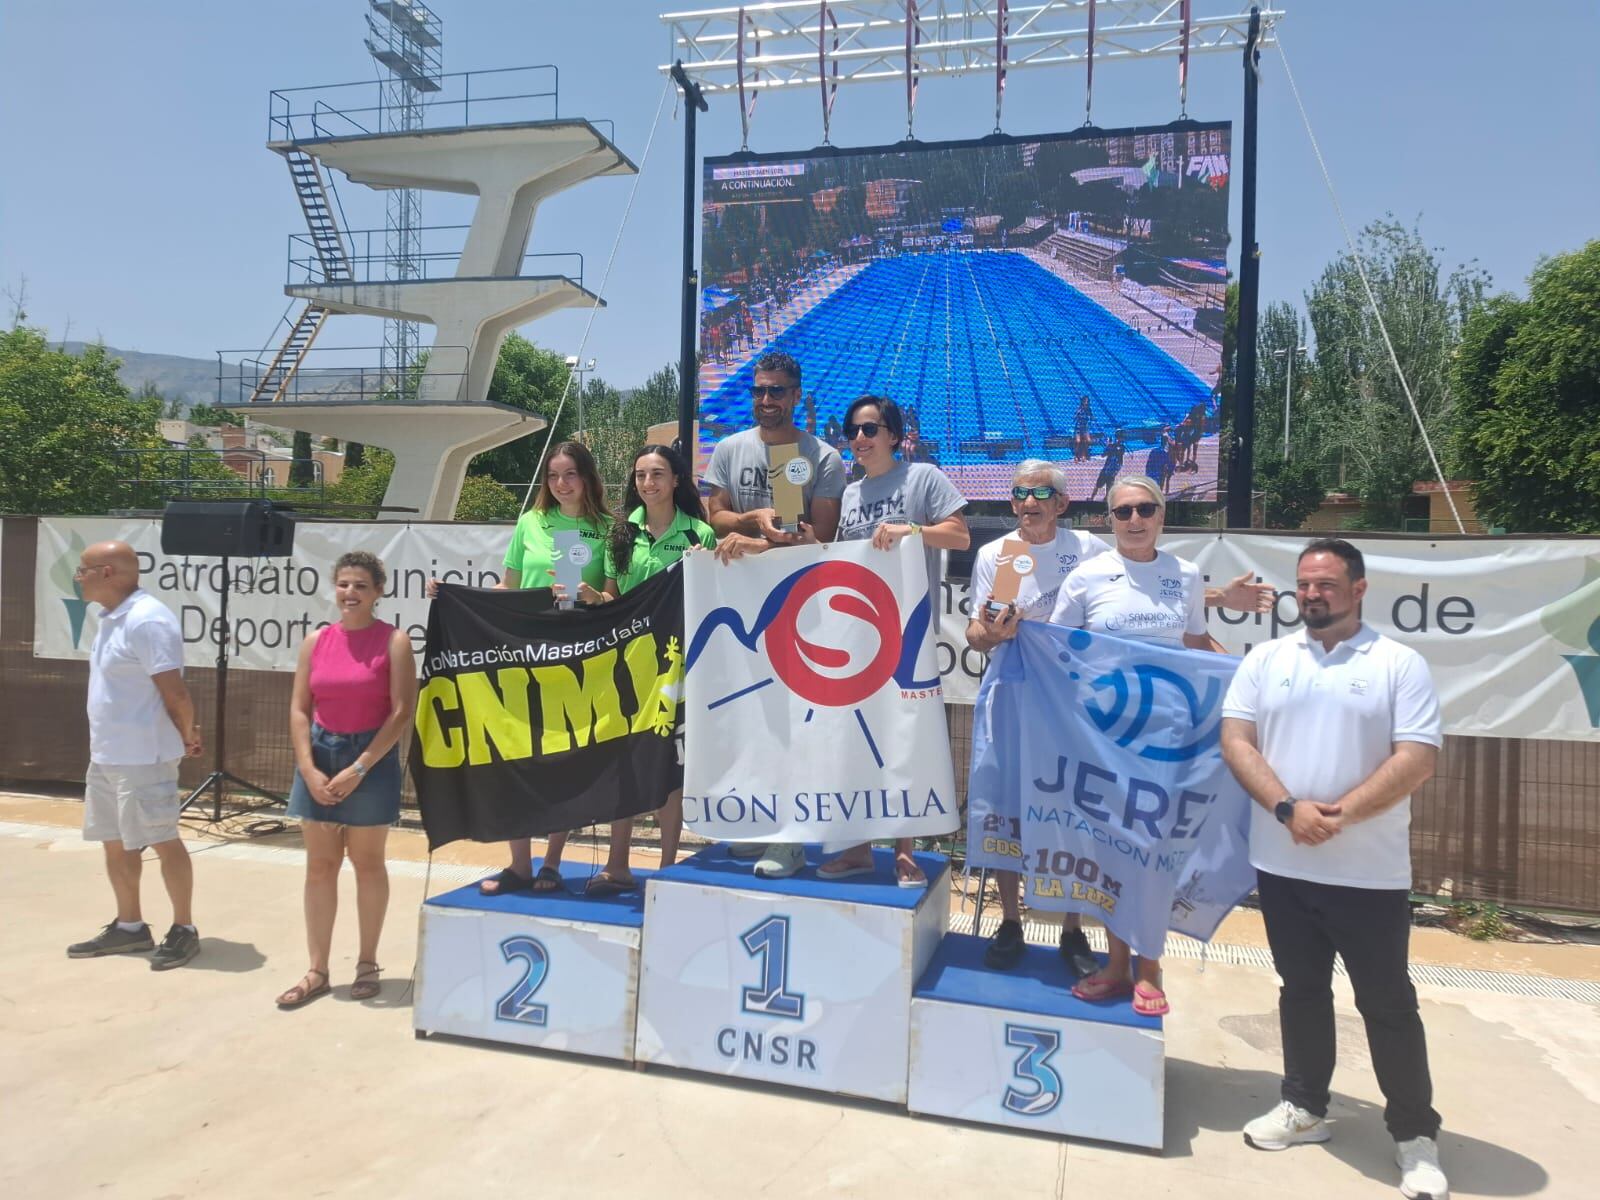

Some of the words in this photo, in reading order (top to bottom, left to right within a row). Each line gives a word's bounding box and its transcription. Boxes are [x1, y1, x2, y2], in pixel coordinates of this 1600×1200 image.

[721, 182, 728, 191] A
[1391, 583, 1476, 635] de
[901, 687, 943, 699] MASTE
[794, 787, 948, 823] SEVILLA
[1033, 755, 1218, 840] JERE
[1033, 877, 1065, 897] LA
[496, 934, 550, 1027] 2
[740, 914, 805, 1022] 1
[716, 1028, 817, 1071] CNSR
[1002, 1023, 1062, 1117] 3
